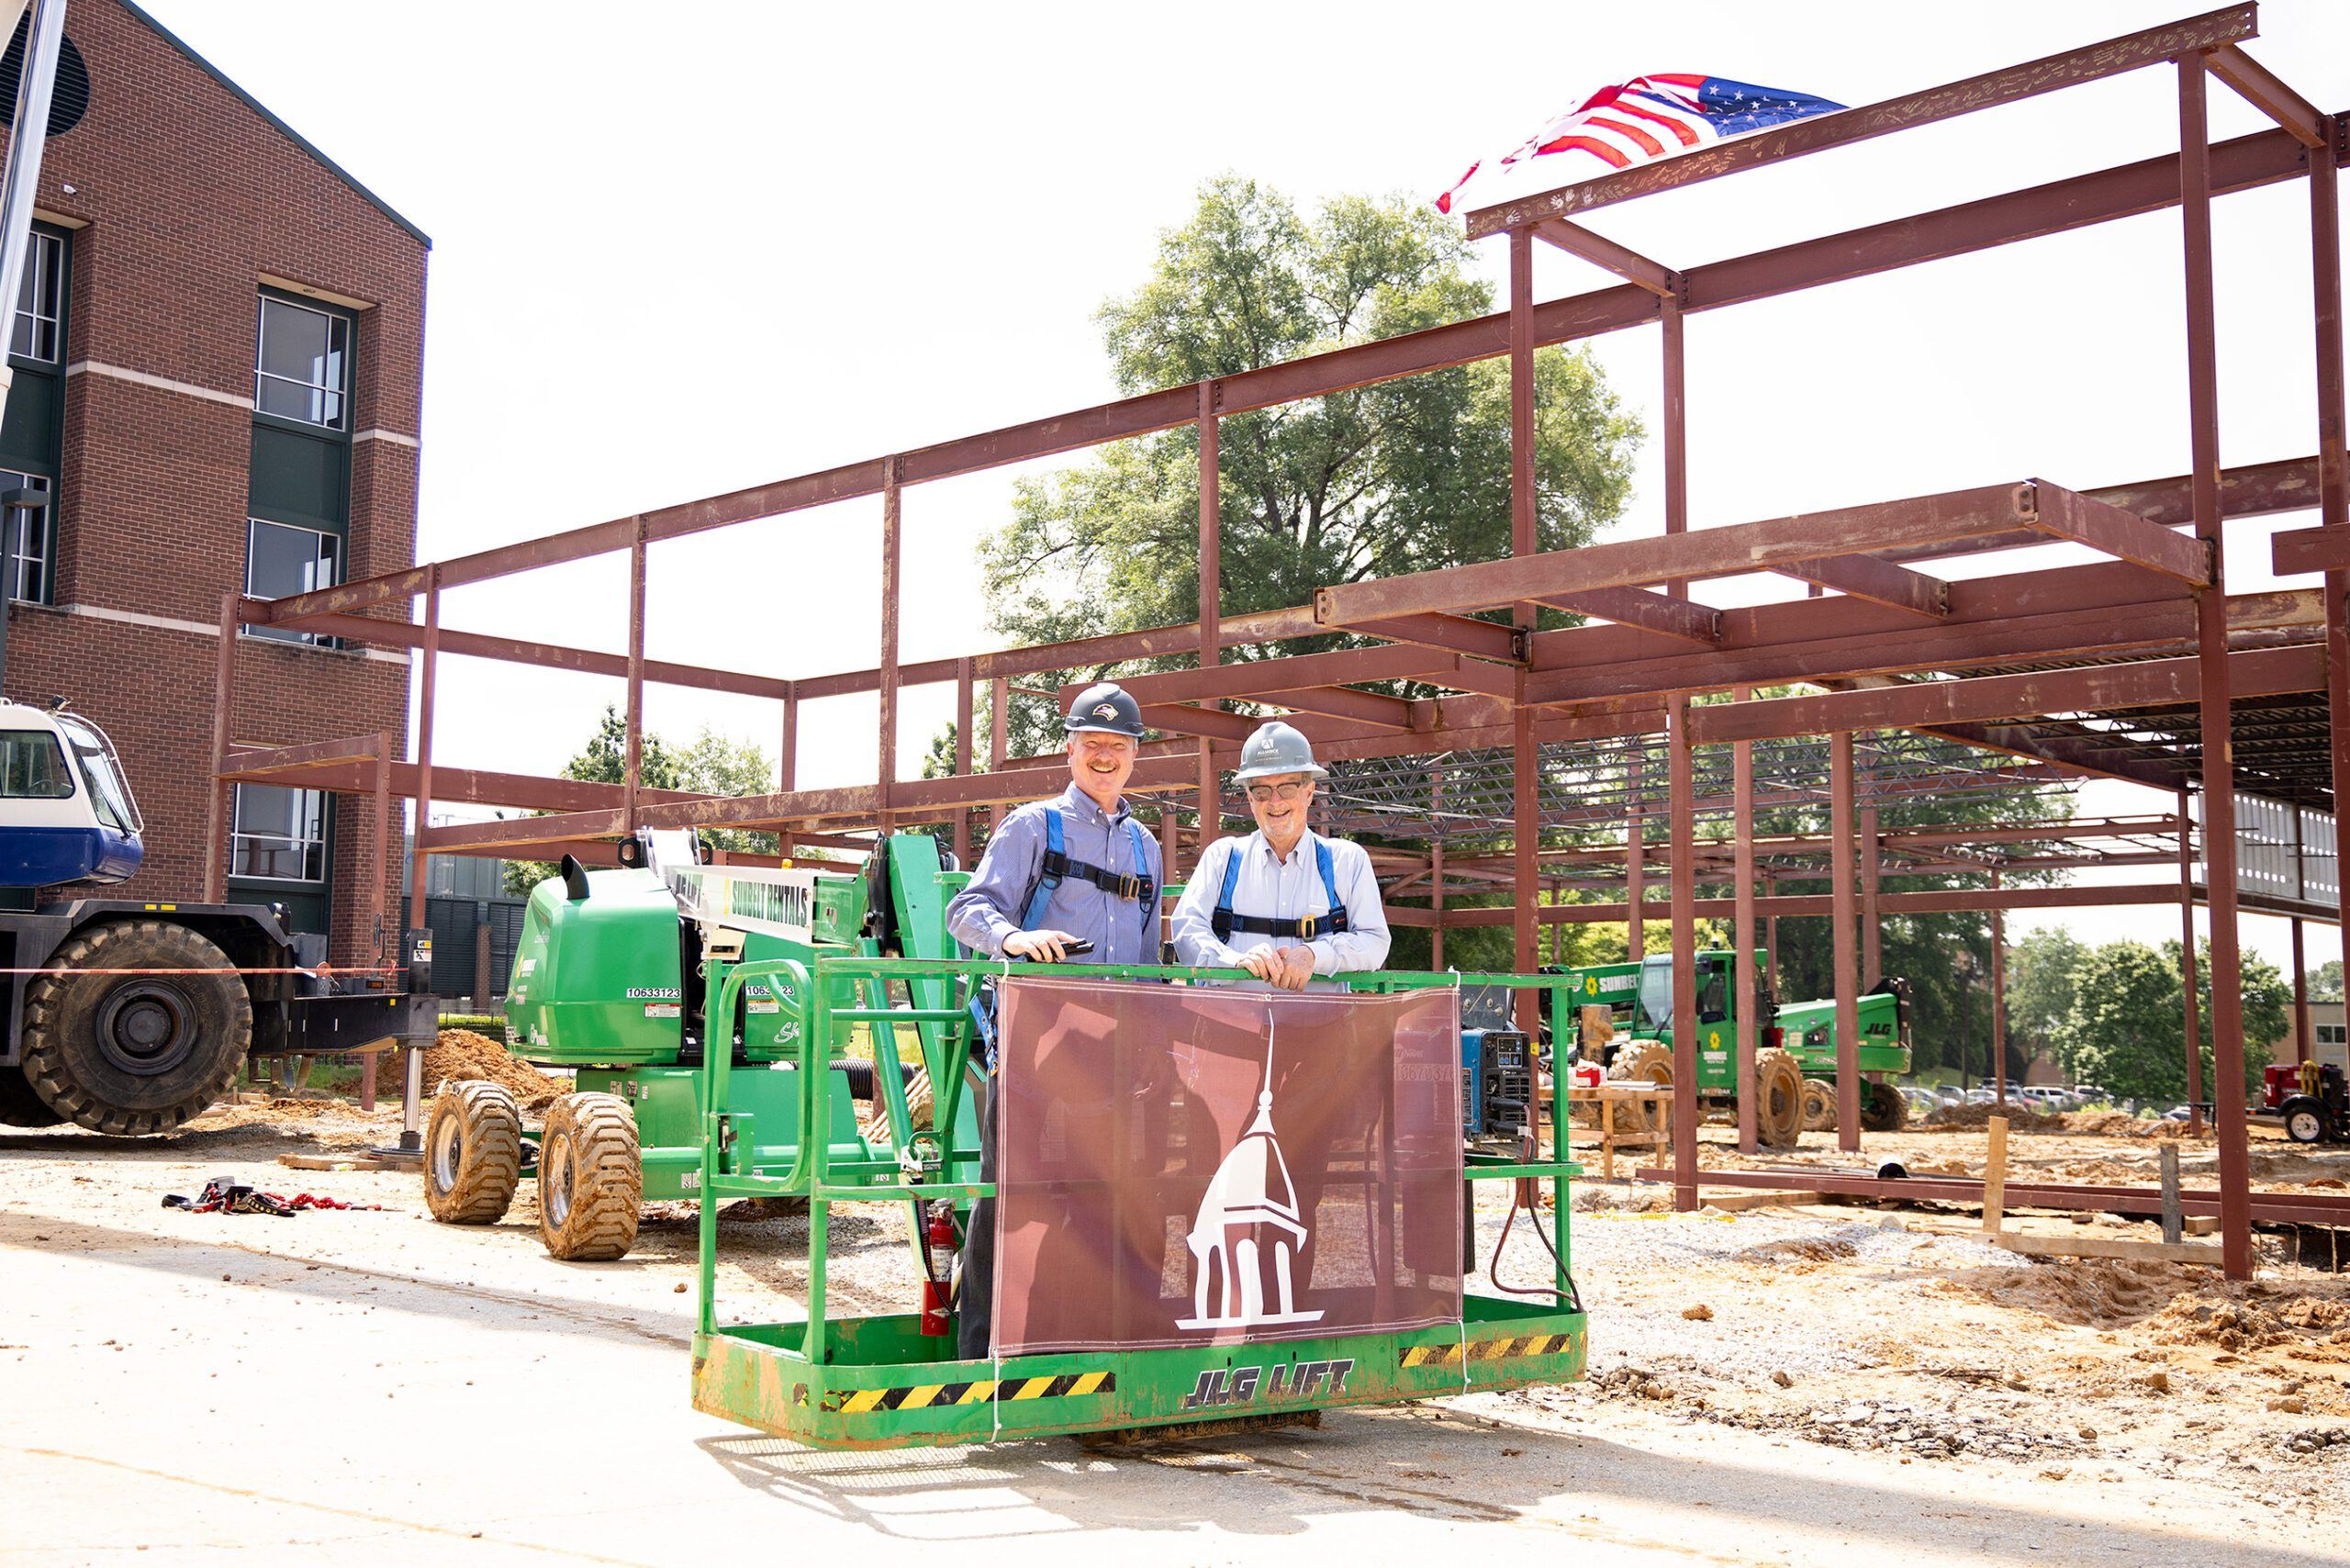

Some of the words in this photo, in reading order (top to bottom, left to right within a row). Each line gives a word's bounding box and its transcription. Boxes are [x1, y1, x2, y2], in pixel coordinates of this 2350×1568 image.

[732, 879, 767, 920] SUNBELT
[767, 883, 808, 928] RENTALS
[747, 986, 794, 995] 106323
[1599, 973, 1639, 992] SUNBEL
[627, 988, 680, 998] 10633123
[1863, 1023, 1891, 1036] JLG
[1181, 1365, 1262, 1410] JLG
[1267, 1358, 1356, 1397] LIFT
